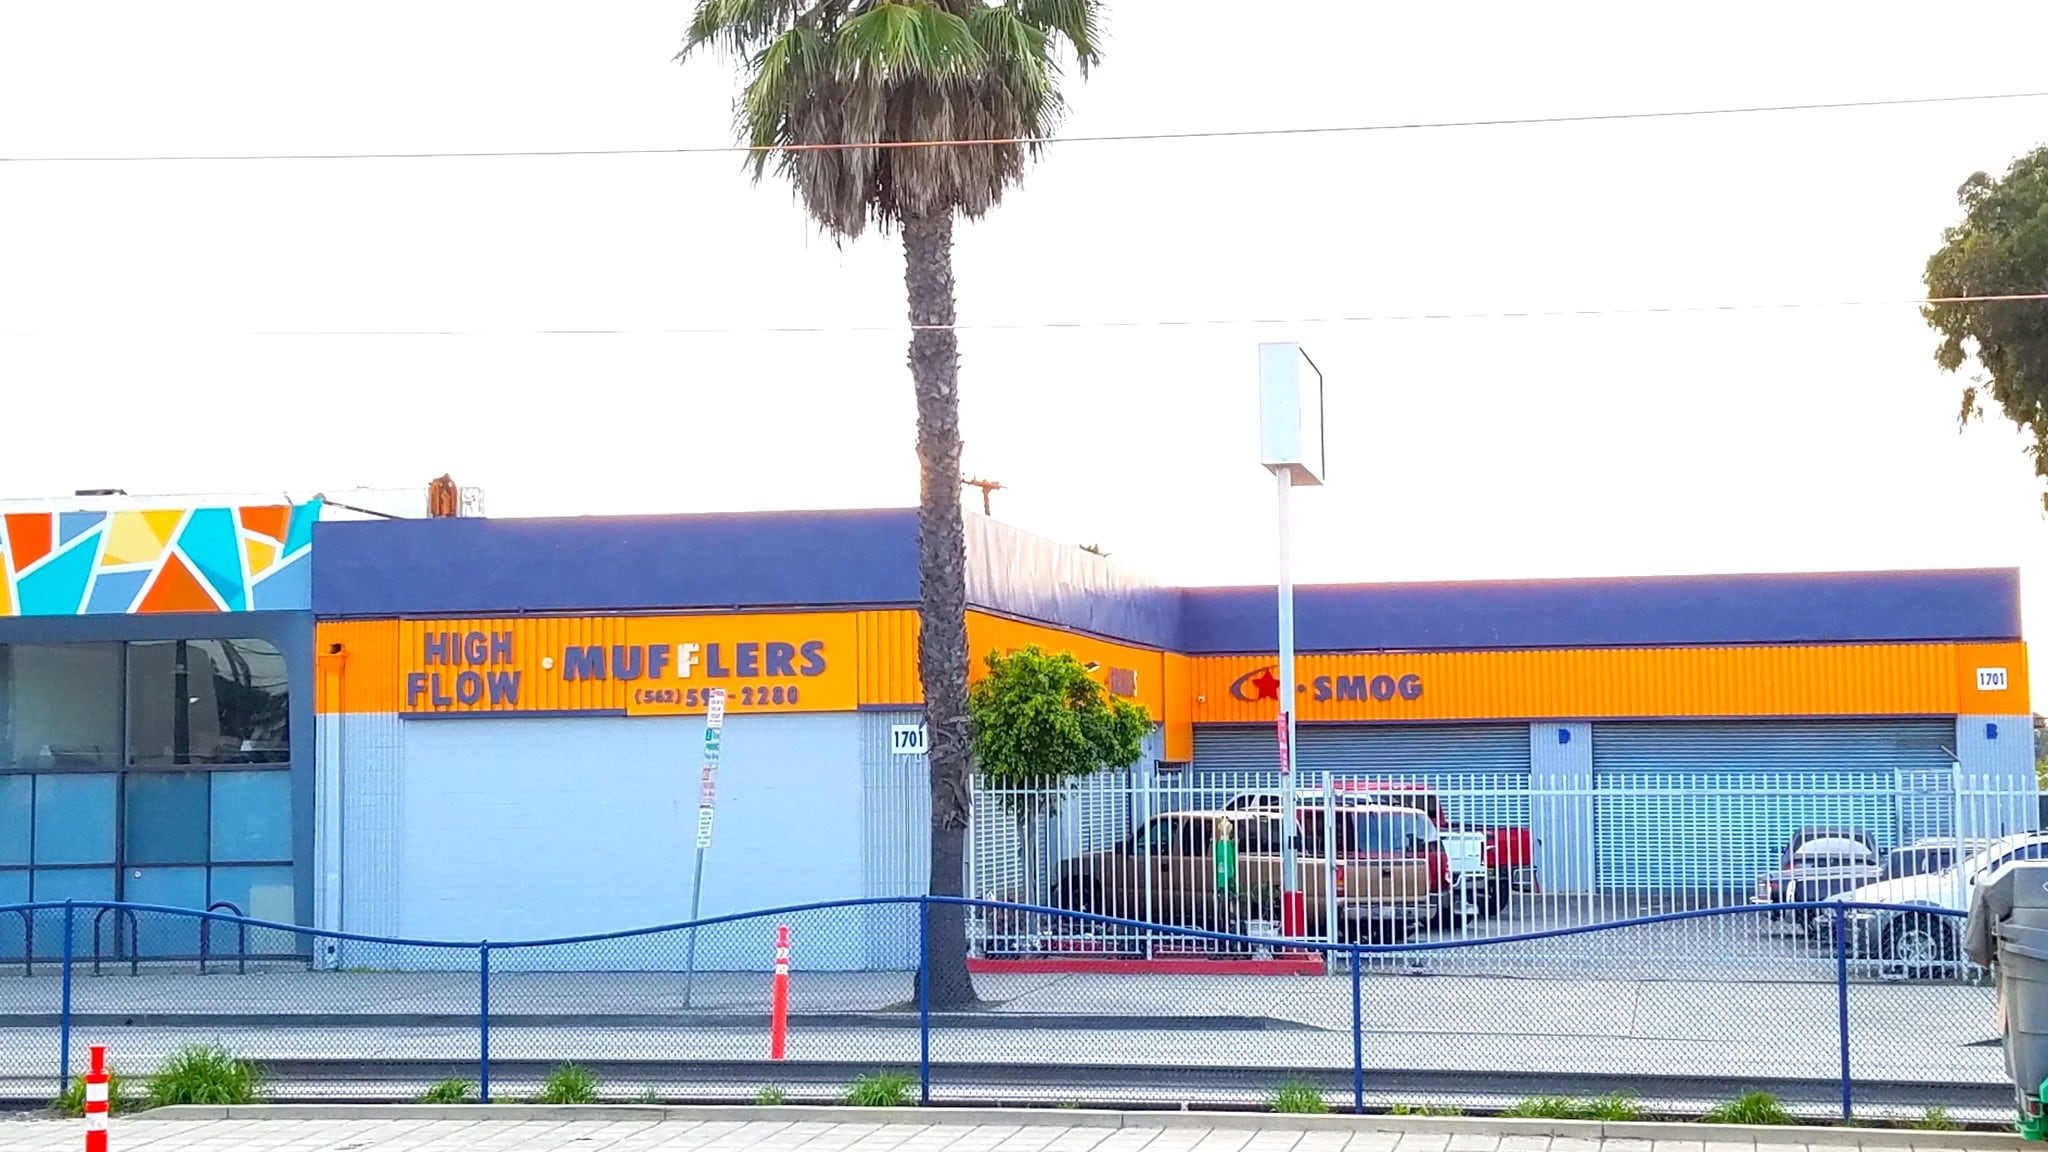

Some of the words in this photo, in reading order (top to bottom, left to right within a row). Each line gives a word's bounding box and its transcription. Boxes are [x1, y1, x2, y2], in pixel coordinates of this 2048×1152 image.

[425, 631, 513, 665] HIGH
[563, 641, 826, 681] MUFFLERS
[1313, 674, 1424, 702] SMOG
[1980, 672, 2004, 686] 1701
[407, 671, 521, 706] FLOW
[634, 688, 682, 705] (562)
[894, 730, 923, 748] 1701
[1558, 728, 1571, 745] D
[1986, 723, 1998, 740] B
